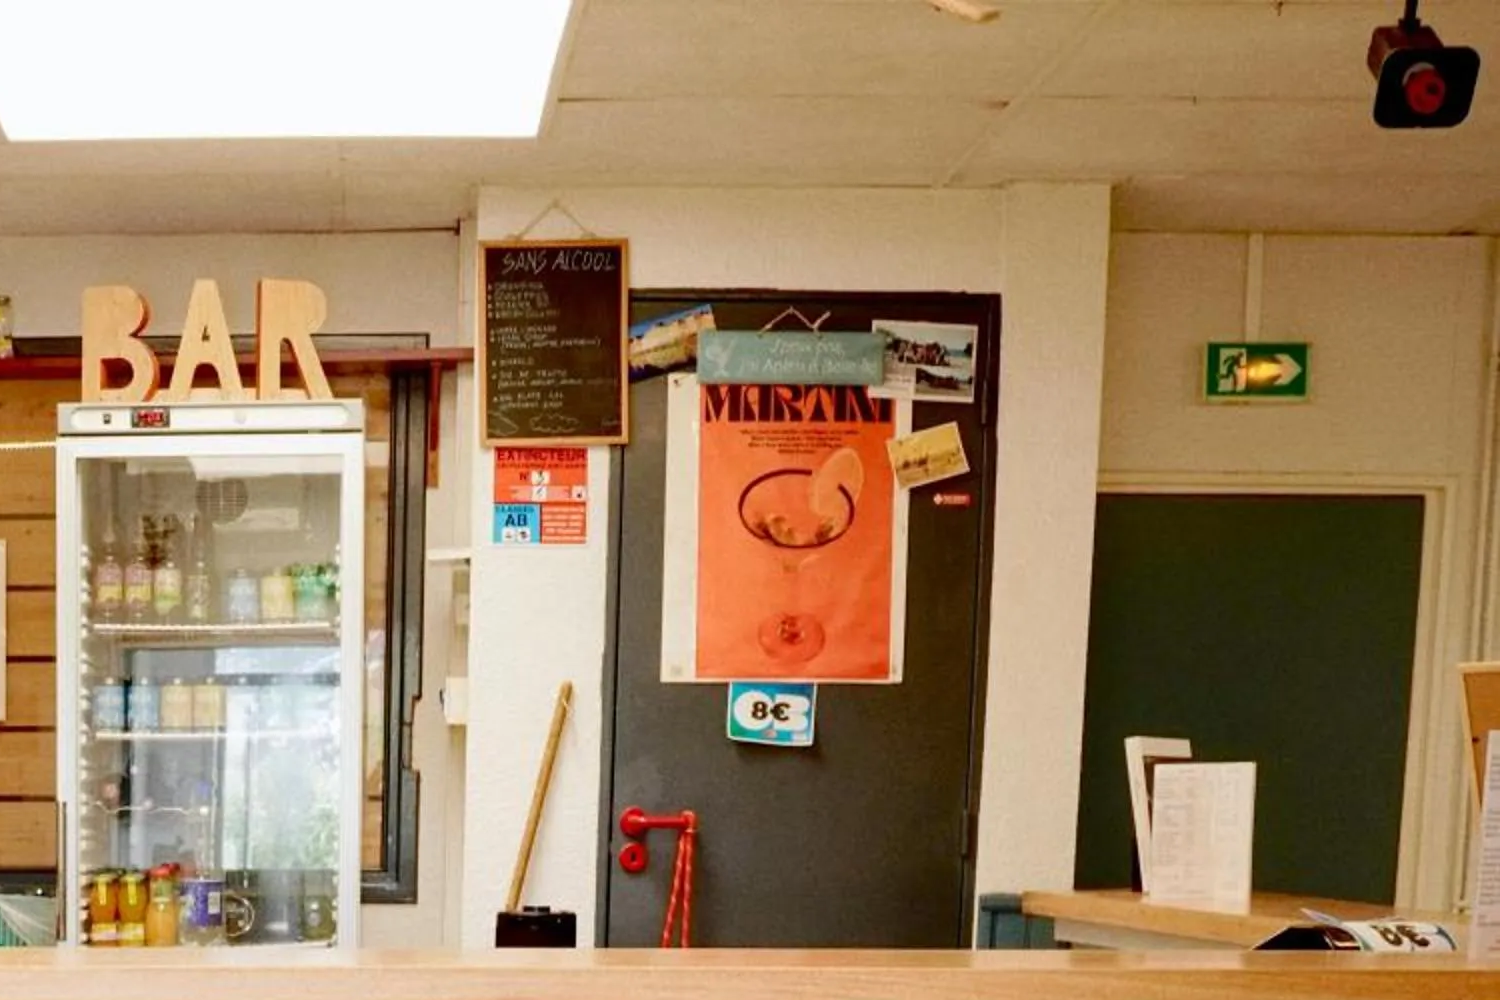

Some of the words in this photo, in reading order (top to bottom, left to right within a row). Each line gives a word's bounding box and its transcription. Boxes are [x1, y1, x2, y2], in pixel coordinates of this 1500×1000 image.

[502, 249, 547, 275] SANS
[552, 249, 616, 271] ALCOOL
[81, 278, 334, 402] BAR
[498, 448, 586, 461] EXTINCTEUR
[505, 513, 527, 527] AB
[751, 701, 790, 721] 8€
